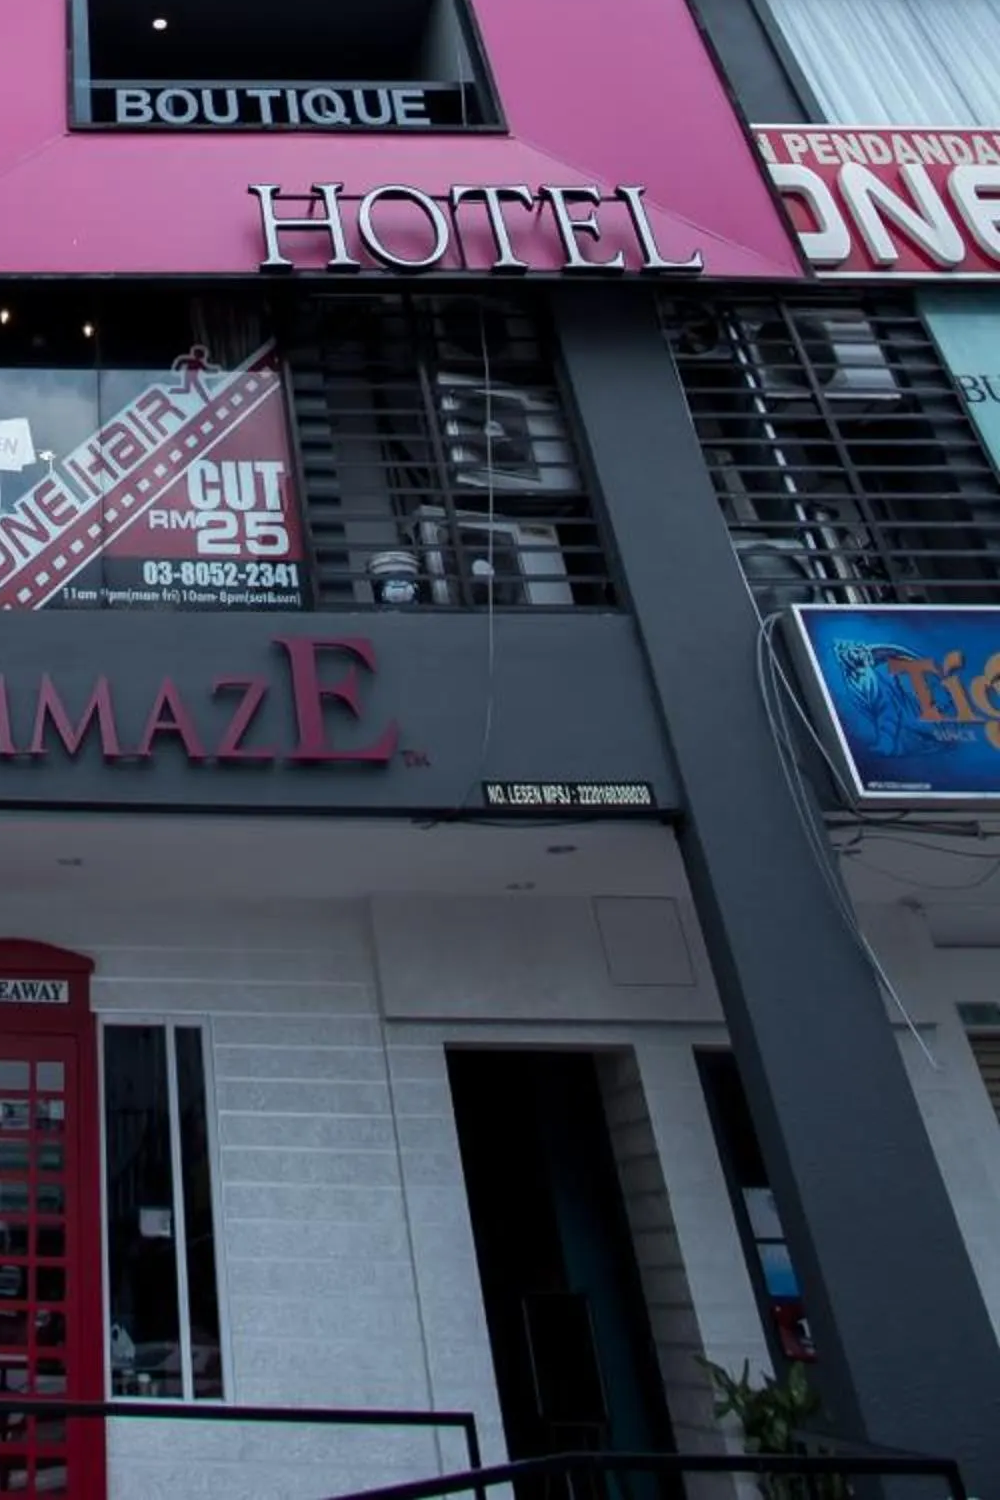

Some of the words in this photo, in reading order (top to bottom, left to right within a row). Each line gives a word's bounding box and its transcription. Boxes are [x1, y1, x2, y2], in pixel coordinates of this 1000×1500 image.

[115, 88, 431, 126] BOUTIQUE
[783, 133, 1000, 165] PENDANDA
[247, 183, 704, 274] HOTEL
[187, 459, 285, 511] CUT
[143, 561, 299, 587] 03-8052-2341
